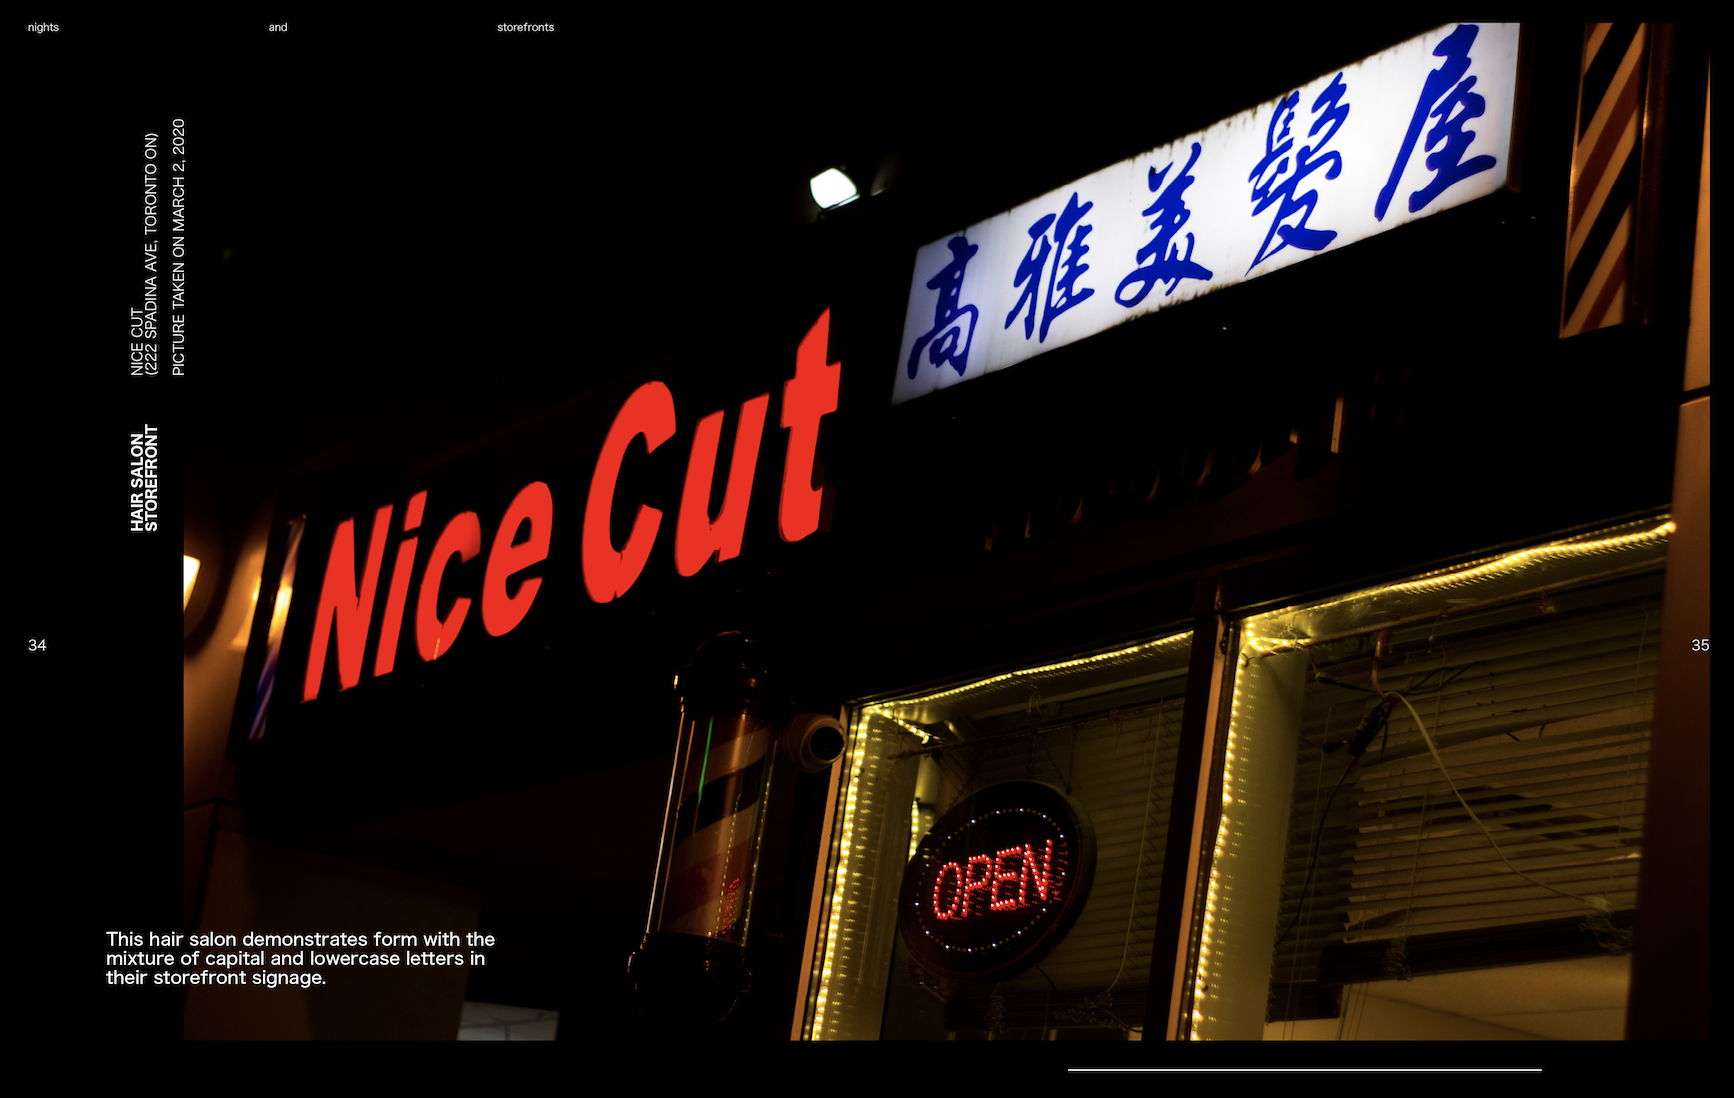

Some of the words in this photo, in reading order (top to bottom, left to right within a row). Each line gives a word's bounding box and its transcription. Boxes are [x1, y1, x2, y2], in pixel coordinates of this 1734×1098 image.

[908, 23, 1496, 380] 高雅美髮屋
[303, 482, 553, 701] Nice
[583, 308, 841, 604] Cut
[932, 838, 1055, 921] OPEN
